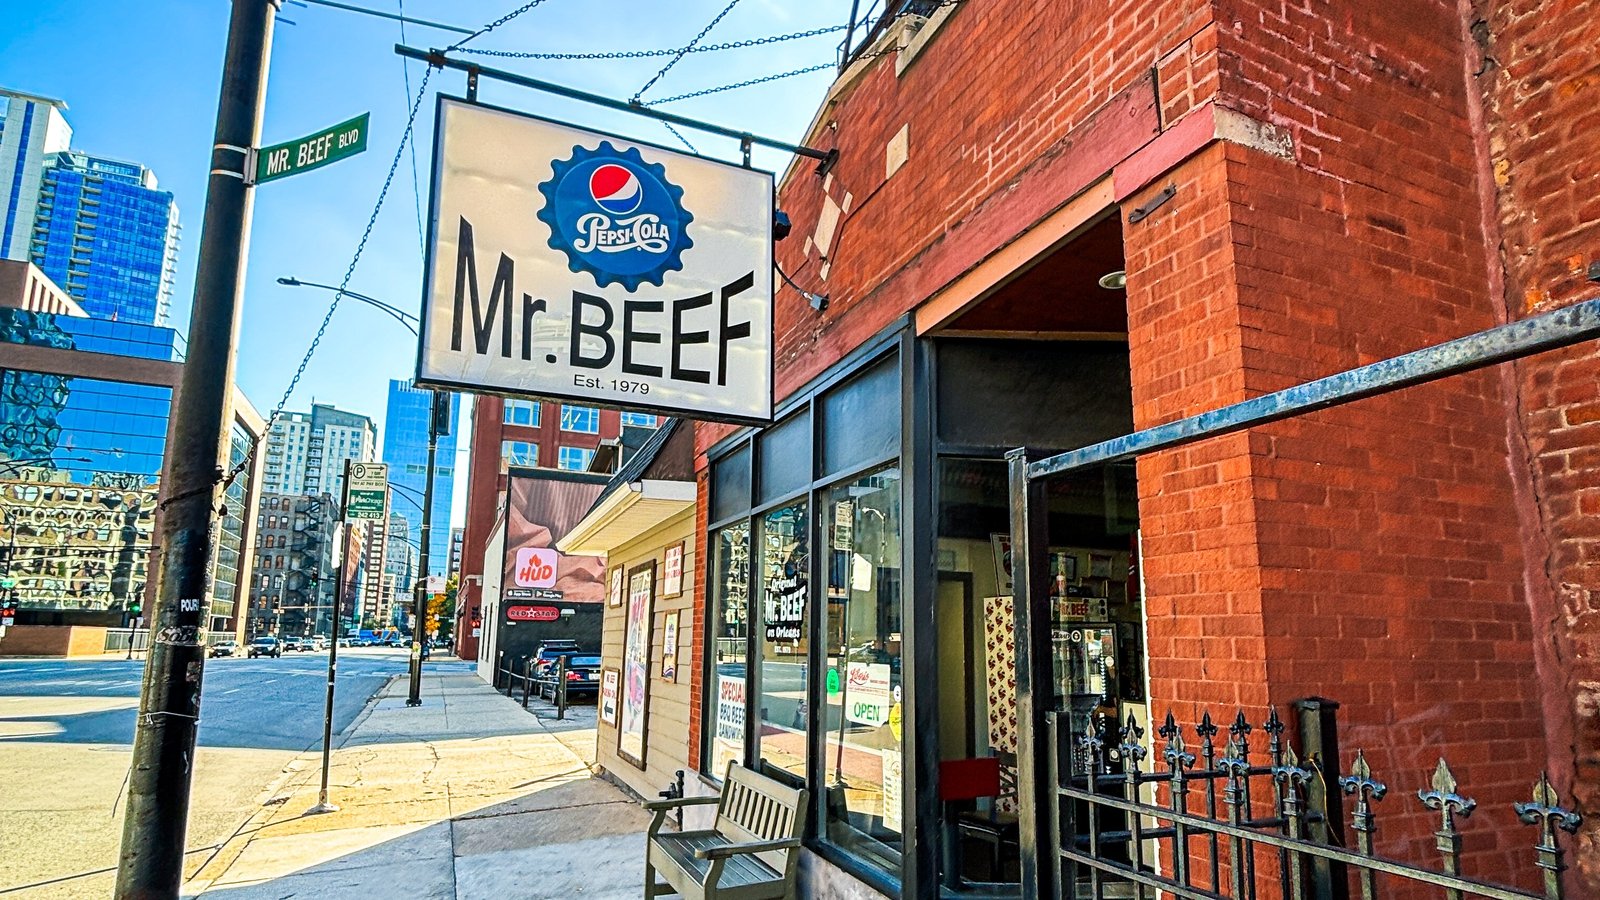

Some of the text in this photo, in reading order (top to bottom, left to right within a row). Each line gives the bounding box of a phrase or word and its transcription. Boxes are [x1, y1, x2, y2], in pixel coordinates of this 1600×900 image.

[266, 128, 359, 176] MR. BEEF BLVD
[450, 214, 755, 387] Mr. BEEF
[573, 373, 650, 396] Est. 1979
[520, 565, 553, 582] HUD
[771, 575, 797, 592] Original
[765, 585, 806, 622] Mr. BEEF
[1071, 603, 1089, 615] BEEF
[767, 626, 801, 638] on Orleans
[721, 680, 746, 703] SPECIAL
[720, 703, 746, 725] BBQ BEEF
[853, 702, 880, 722] OPEN
